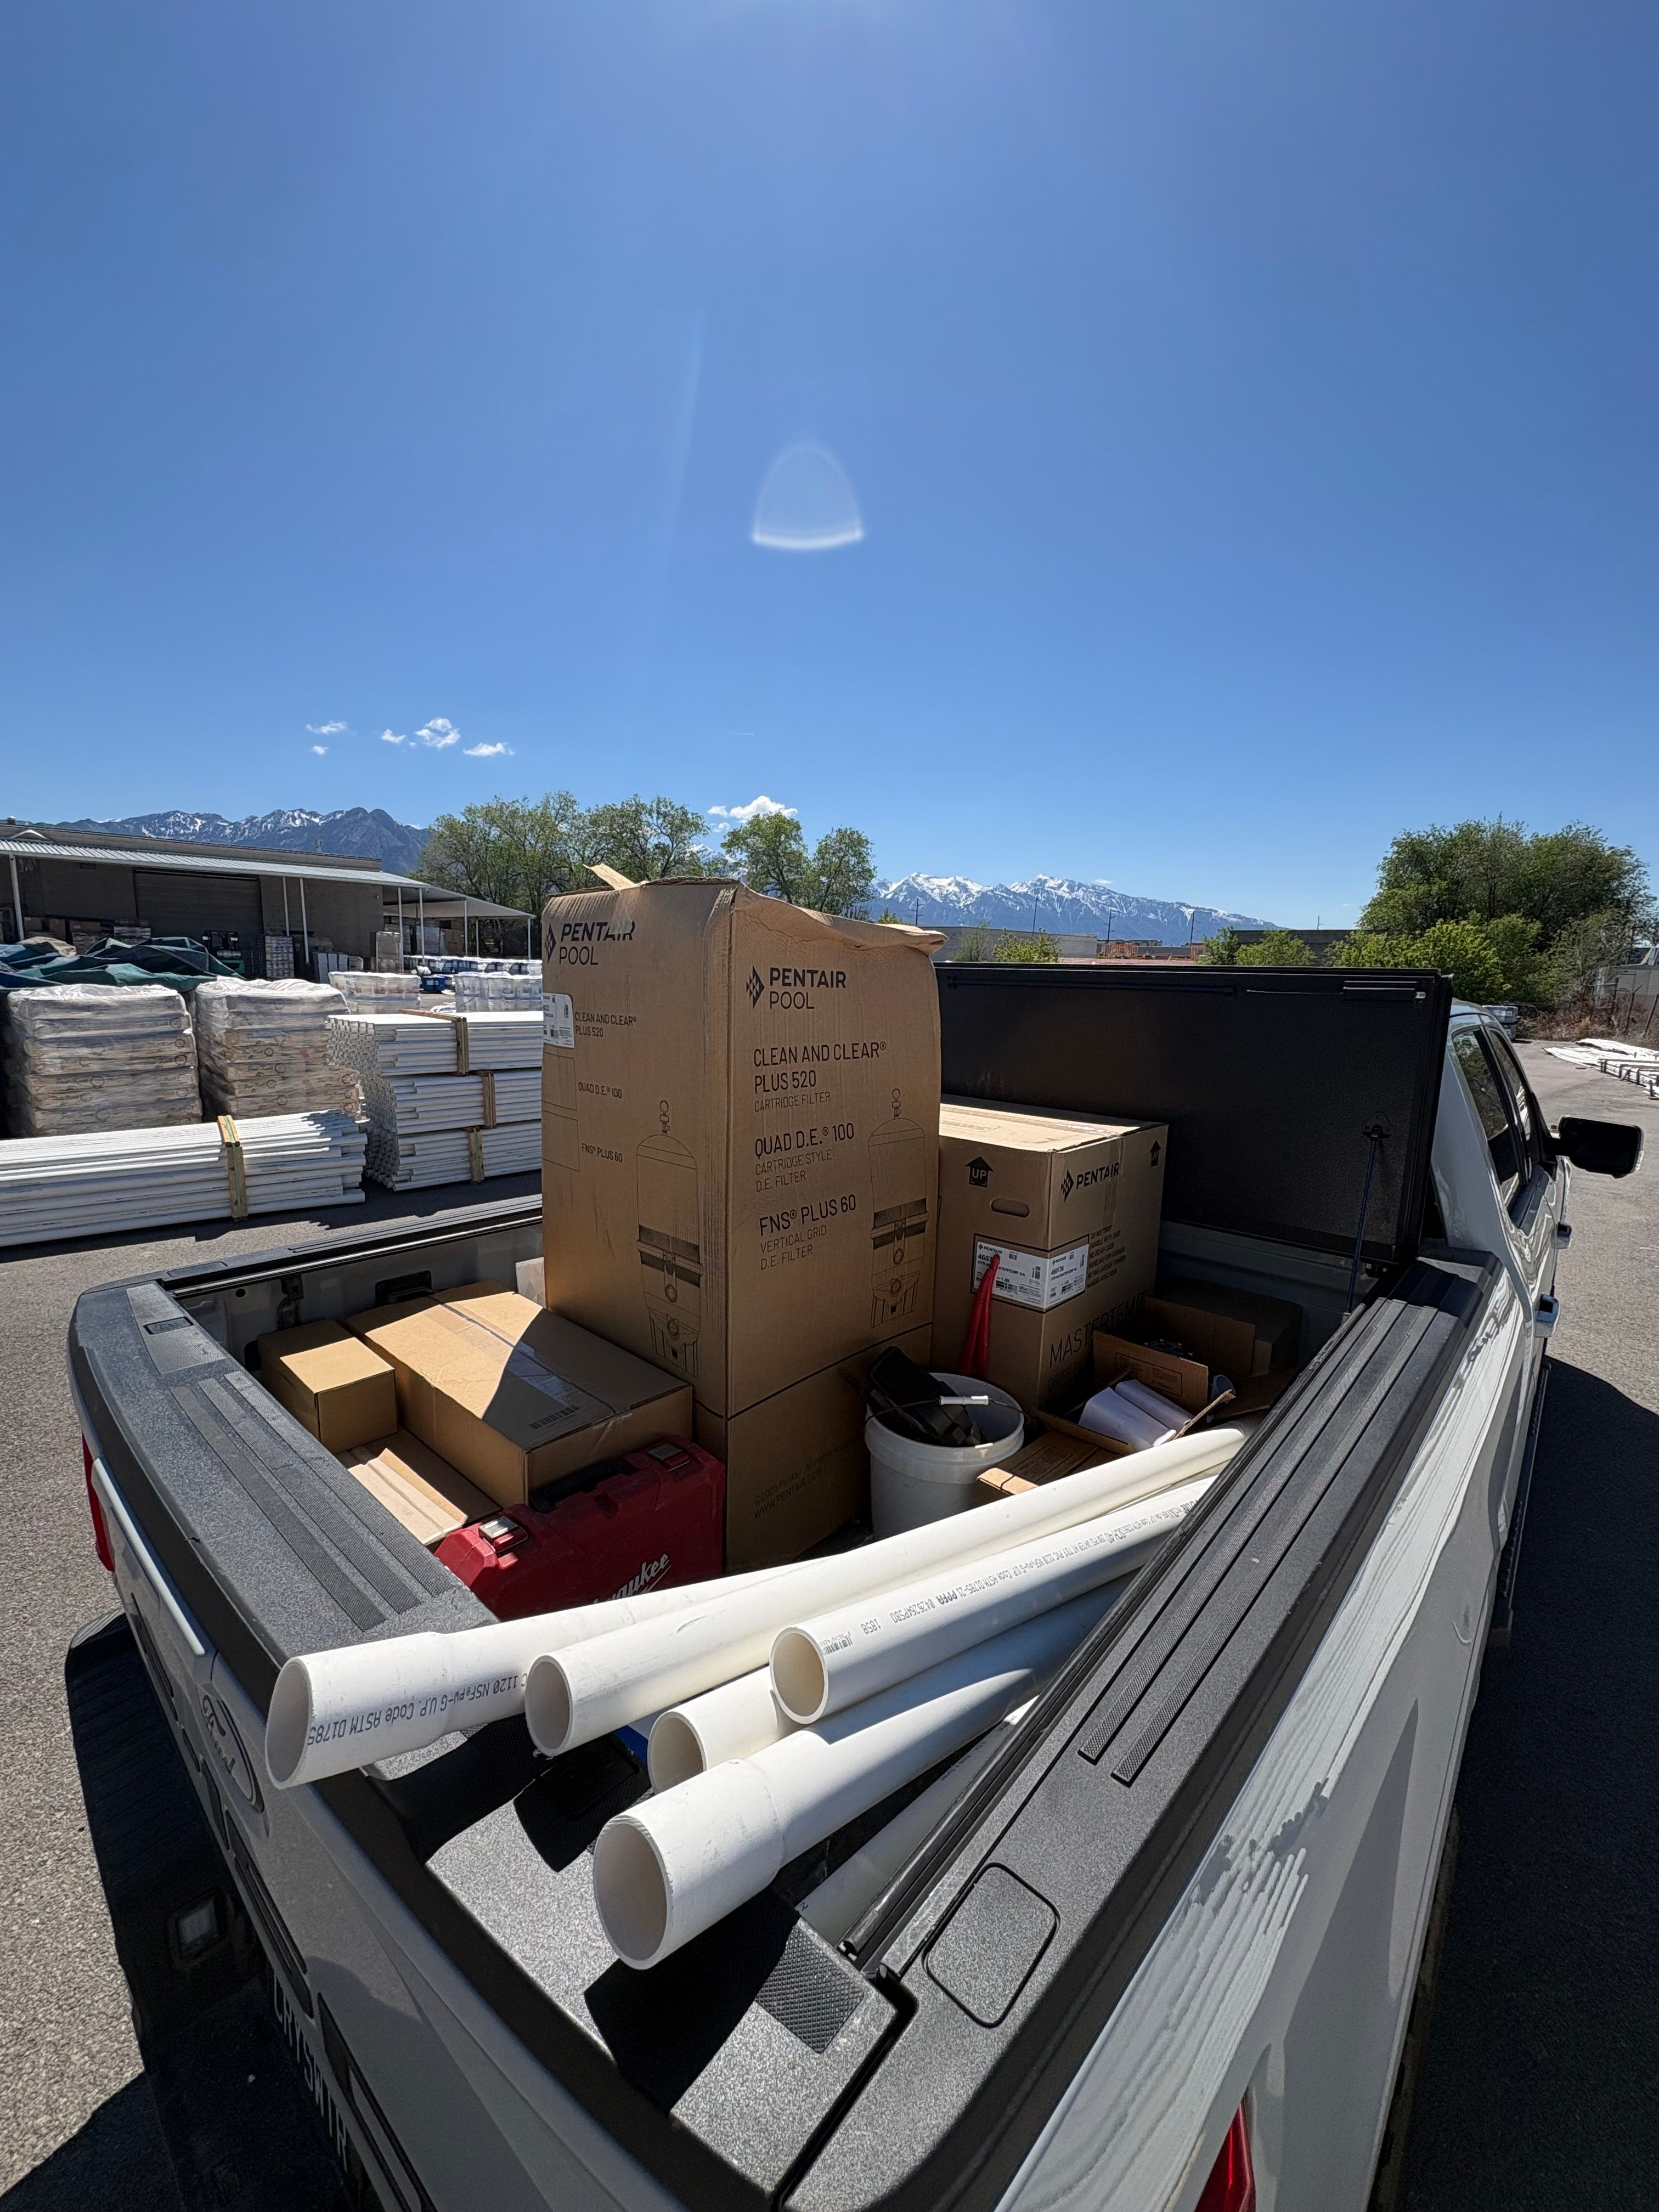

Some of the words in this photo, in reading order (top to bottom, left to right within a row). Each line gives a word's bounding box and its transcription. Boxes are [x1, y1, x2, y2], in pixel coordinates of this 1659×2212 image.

[559, 946, 599, 965] POOL
[770, 967, 847, 988] PENTAIR
[770, 991, 815, 1009] POOL
[575, 1012, 594, 1023] CLEAN
[596, 1014, 610, 1024] AND
[575, 1025, 591, 1036] PLUS
[592, 1028, 603, 1037] 520
[754, 1046, 798, 1067] CLEAN
[802, 1045, 830, 1063] AND
[833, 1041, 887, 1060] CLEAR®
[578, 1082, 594, 1093] QUAD
[612, 1088, 622, 1098] 100
[755, 1073, 788, 1093] PLUS
[792, 1070, 816, 1088] 520
[755, 1095, 800, 1112] CARTRIDGE
[802, 1091, 831, 1104] FILTER
[755, 1133, 792, 1159] QUAD
[832, 1122, 854, 1141] 100
[597, 1147, 613, 1160] PLUS
[615, 1152, 622, 1163] 60
[756, 1155, 804, 1175] CARTRIDGE
[806, 1149, 832, 1165] STYLE
[1152, 1152, 1158, 1160] UP
[756, 1177, 773, 1192] D.E.
[775, 1170, 806, 1186] FILTER
[973, 1168, 986, 1179] UP
[1076, 1163, 1120, 1189] PENTAIR
[760, 1209, 797, 1236] FNS®
[801, 1199, 838, 1224] PLUS
[840, 1194, 856, 1212] 60
[760, 1232, 805, 1254] VERTICAL
[807, 1225, 827, 1240] GRID
[760, 1255, 779, 1270] D.E.
[782, 1244, 812, 1264] FILTER
[1104, 1532, 1115, 1543] 40
[593, 1553, 670, 1603] aukee
[996, 1570, 1012, 1581] Code
[935, 1590, 957, 1604] PPFA
[860, 1618, 881, 1634] 1858
[493, 1673, 517, 1695] 1120
[351, 1707, 380, 1736] ASTM
[385, 1700, 415, 1726] Code
